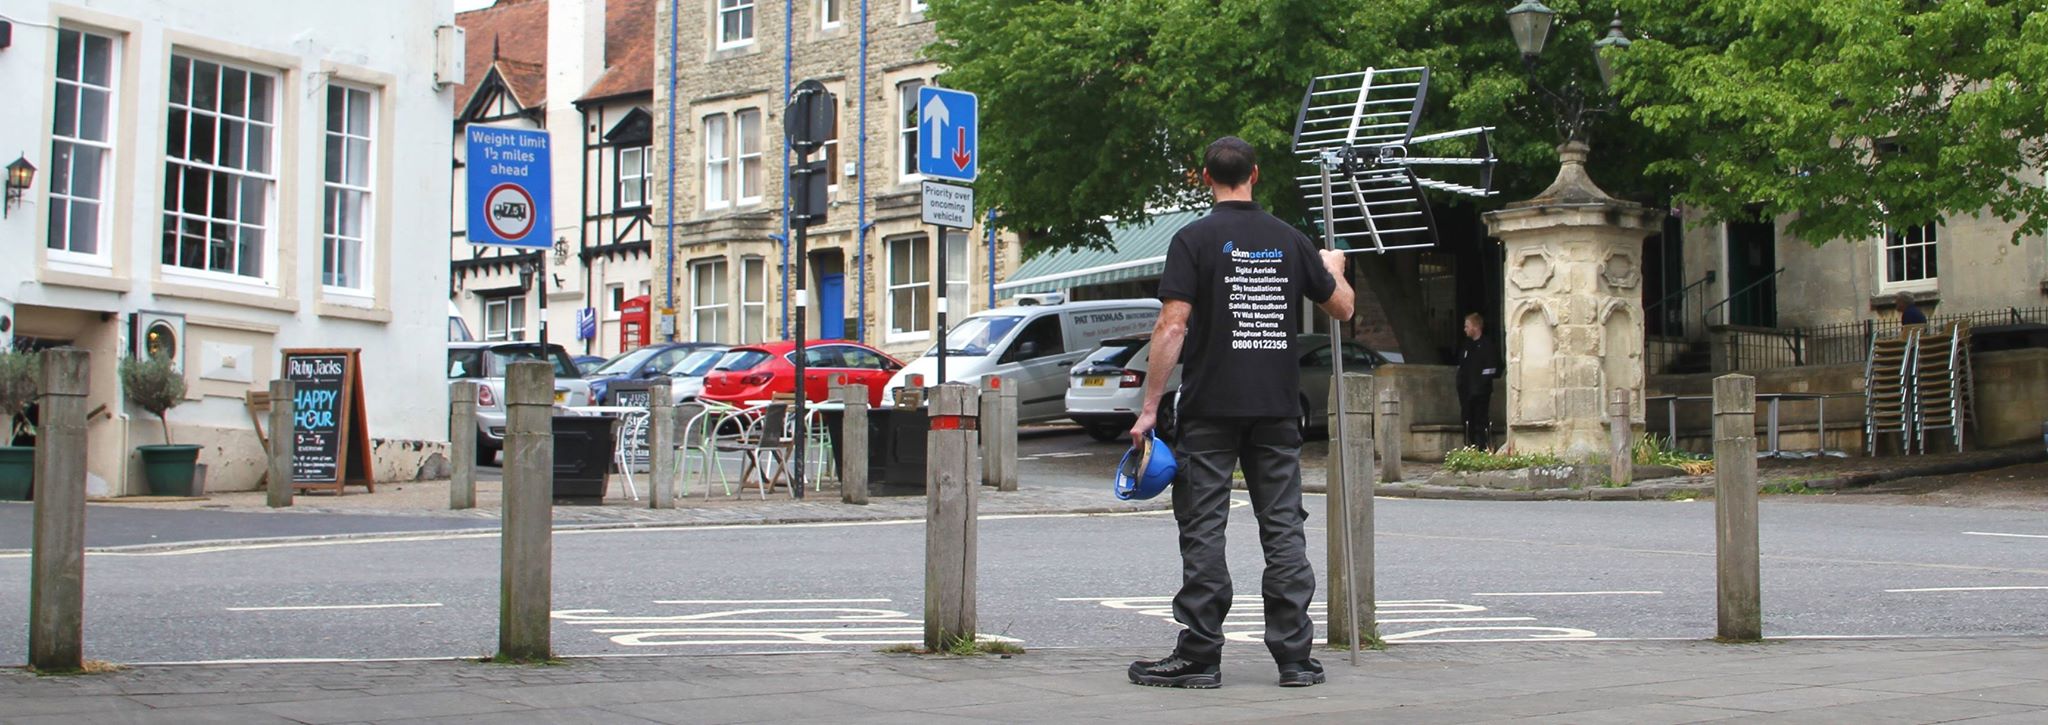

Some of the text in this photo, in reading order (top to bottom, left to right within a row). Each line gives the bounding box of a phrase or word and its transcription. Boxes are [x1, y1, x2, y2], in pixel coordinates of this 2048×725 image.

[472, 131, 547, 149] Weight limit
[502, 149, 535, 162] miles
[490, 163, 529, 176] ahead
[925, 186, 971, 201] Priority over
[930, 200, 966, 213] oncoming
[933, 211, 963, 222] vehicles
[1235, 266, 1252, 275] Digital
[1232, 284, 1243, 293] Sky
[1229, 293, 1247, 301] CCTV
[1074, 315, 1088, 325] PAT
[1090, 312, 1125, 323] THOMAS
[1254, 312, 1284, 320] Mounting
[1232, 330, 1262, 338] Telephone
[1232, 340, 1288, 349] 0800 0122356
[290, 359, 342, 378] Ruby Jacks
[293, 389, 338, 410] HAPPY
[294, 409, 335, 429] HOUR
